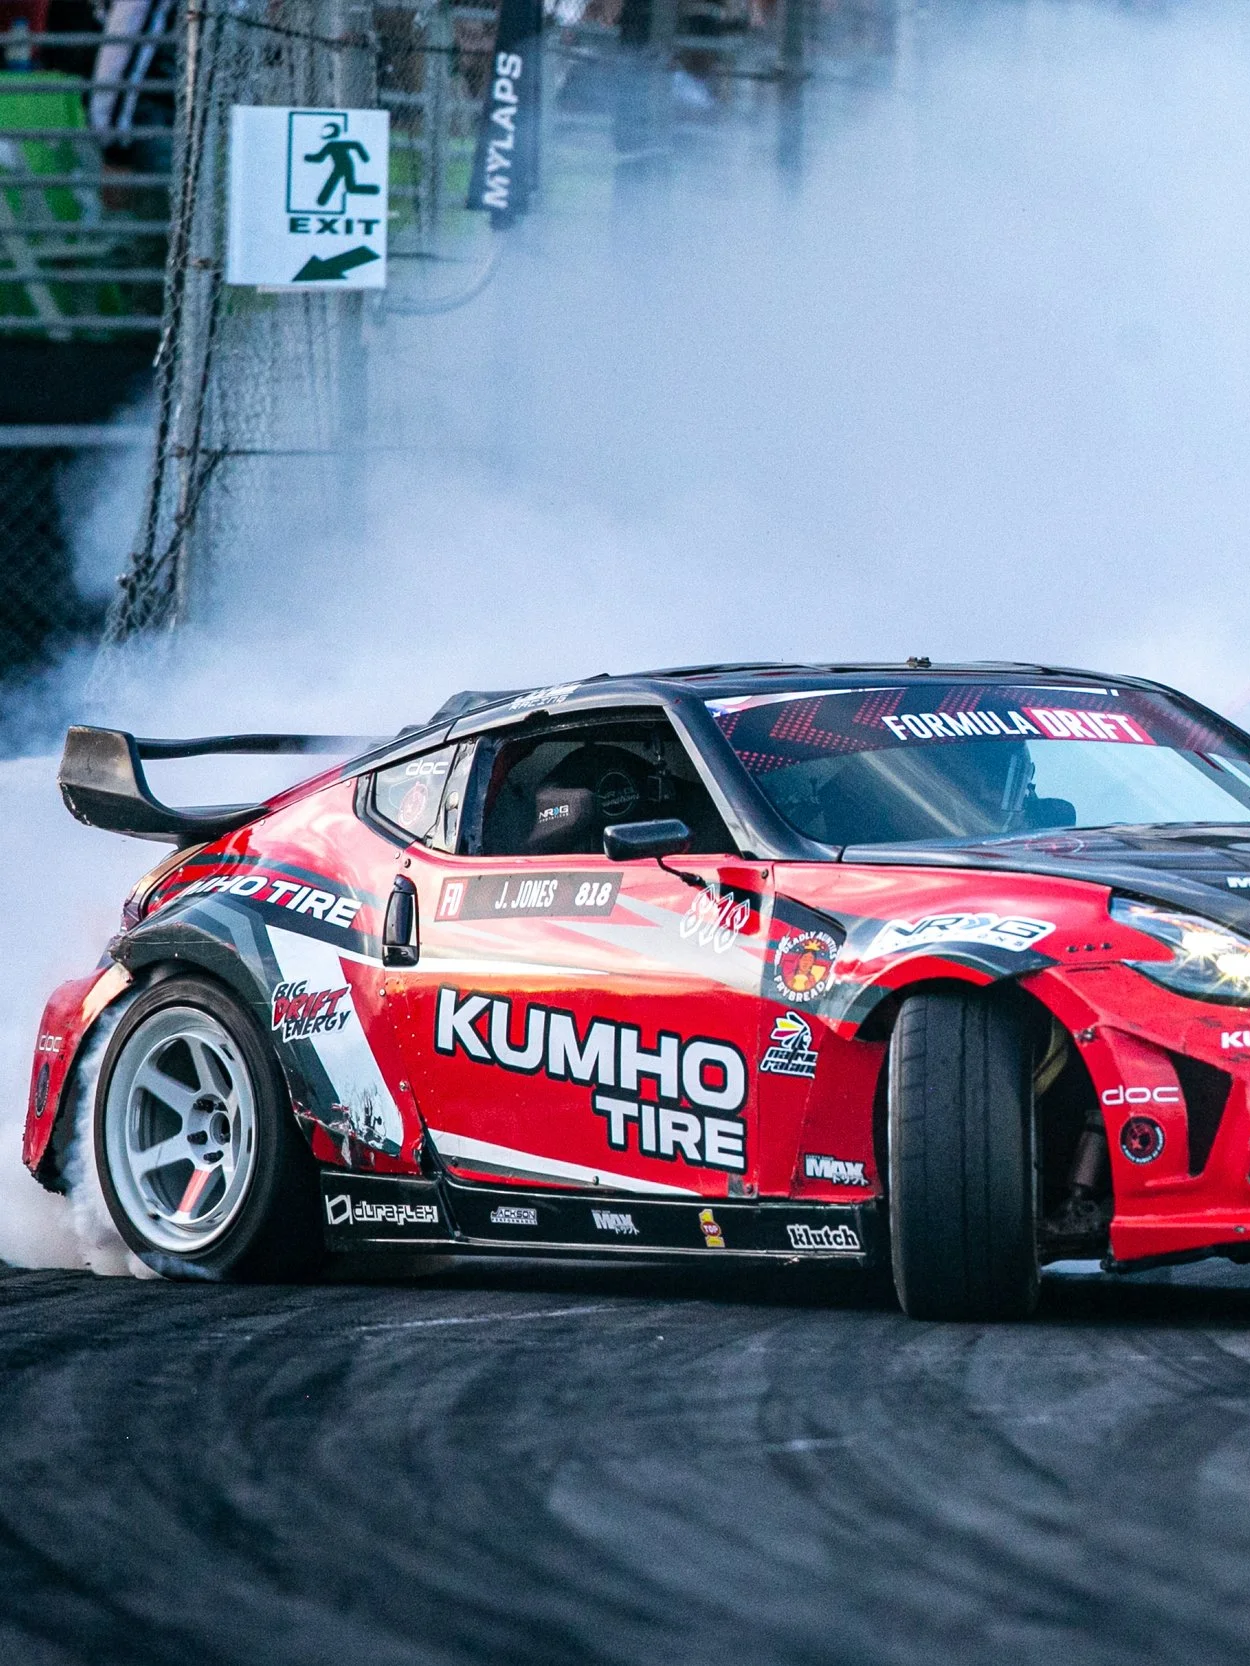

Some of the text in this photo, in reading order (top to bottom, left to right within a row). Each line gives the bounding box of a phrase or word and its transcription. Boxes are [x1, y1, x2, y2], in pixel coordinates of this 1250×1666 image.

[483, 52, 522, 208] MYLAPS
[289, 217, 380, 235] EXIT
[881, 709, 1144, 742] FORMULA DRIFT
[406, 760, 448, 776] doc
[265, 882, 362, 928] TIRE
[440, 879, 612, 916] FD J. JONES 818
[274, 980, 308, 1001] BIG
[774, 975, 826, 1003] FRYBREAD
[273, 987, 350, 1027] DRIFT
[284, 1011, 351, 1039] ENERGY
[437, 988, 745, 1111] KUMHO
[1102, 1085, 1179, 1105] doc
[595, 1095, 745, 1169] TIRE
[806, 1159, 864, 1178] MAX
[491, 1207, 536, 1219] JACKSON
[592, 1212, 632, 1229] MAX
[788, 1226, 859, 1248] klutch
